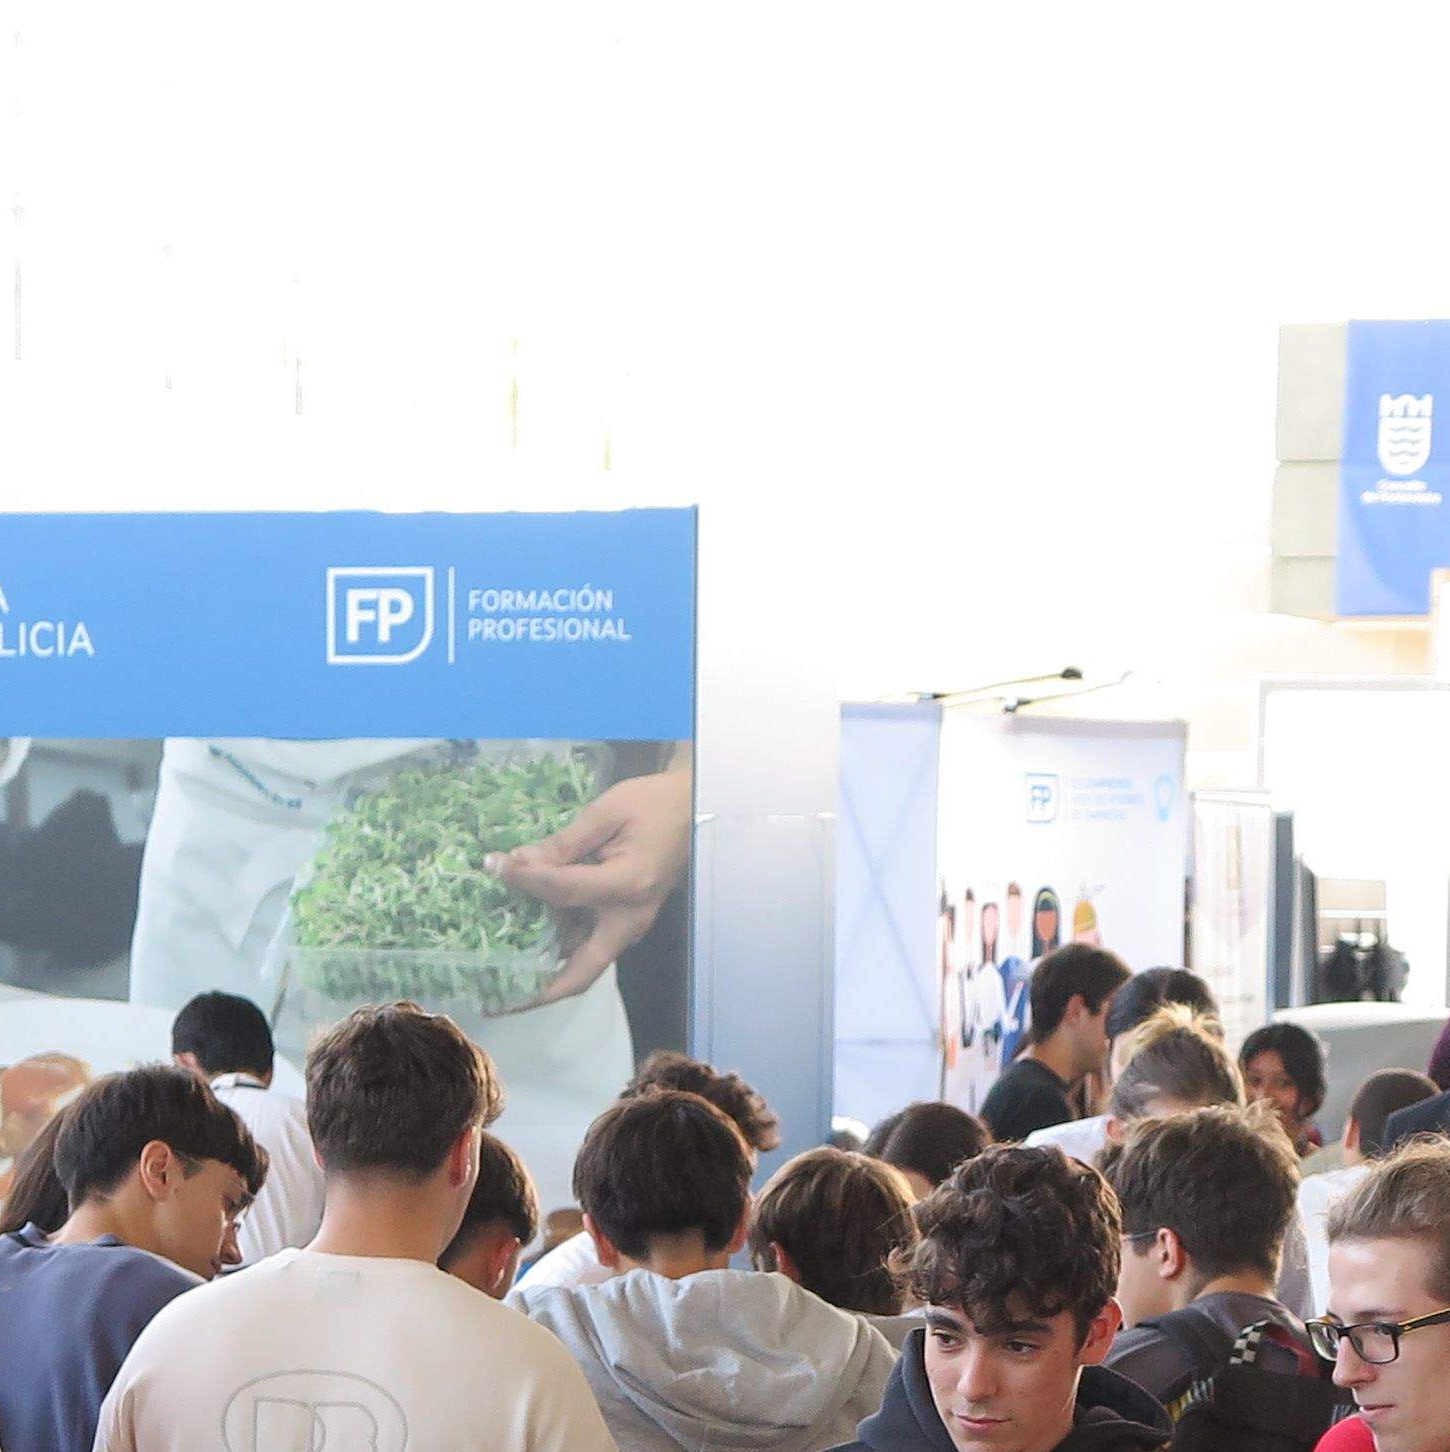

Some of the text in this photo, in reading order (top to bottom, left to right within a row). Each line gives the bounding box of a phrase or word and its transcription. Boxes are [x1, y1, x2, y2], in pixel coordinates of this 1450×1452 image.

[468, 582, 613, 613] FORMACIÓN
[346, 588, 415, 643] FP
[468, 617, 632, 642] PROFESIONAL
